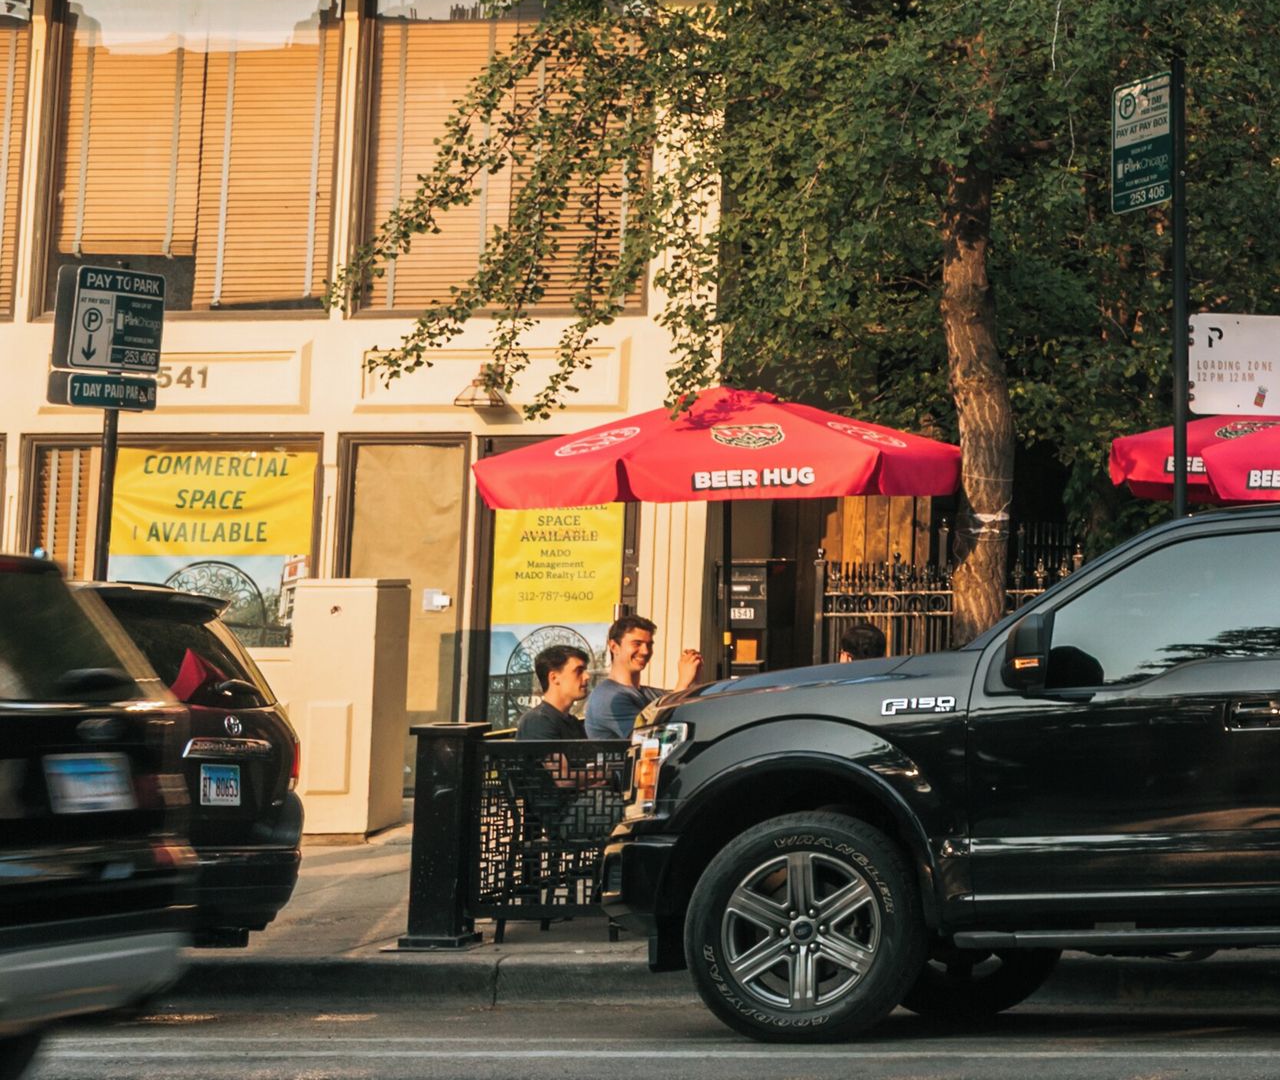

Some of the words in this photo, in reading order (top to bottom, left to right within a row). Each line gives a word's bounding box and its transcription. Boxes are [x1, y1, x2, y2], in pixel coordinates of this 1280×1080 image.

[1116, 128, 1129, 139] PAY
[1130, 125, 1138, 134] AT
[1139, 121, 1152, 132] PAY
[1153, 117, 1168, 128] BOX
[1130, 191, 1146, 206] 253
[1148, 185, 1165, 200] 406
[86, 272, 114, 288] PAY
[116, 276, 131, 290] TO
[133, 278, 160, 294] PARK
[1208, 327, 1224, 348] P
[124, 351, 139, 363] 253
[141, 352, 156, 364] 406
[1197, 360, 1241, 370] LOADING
[1248, 361, 1273, 372] ZONE
[1197, 373, 1207, 382] 12
[1210, 373, 1224, 382] PM
[1230, 373, 1239, 382] 12
[1241, 373, 1255, 382] AM
[73, 383, 80, 396] 7
[83, 383, 102, 397] DAY
[104, 384, 125, 398] PAID
[144, 455, 289, 477] COMMERCIAL
[694, 469, 758, 490] BEER
[762, 467, 815, 487] HUG
[175, 489, 246, 510] SPACE
[537, 515, 581, 527] SPACE
[146, 522, 267, 543] AVAILABLE
[520, 531, 598, 542] AVAILABLE
[540, 549, 571, 557] MADO
[527, 560, 584, 570] Management
[515, 571, 543, 580] MADO
[546, 571, 574, 581] Realty
[577, 571, 596, 579] LLC
[519, 591, 594, 601] 312-787-9400
[774, 835, 895, 914] WRANGLER
[703, 944, 831, 1027] GOODYEAR
